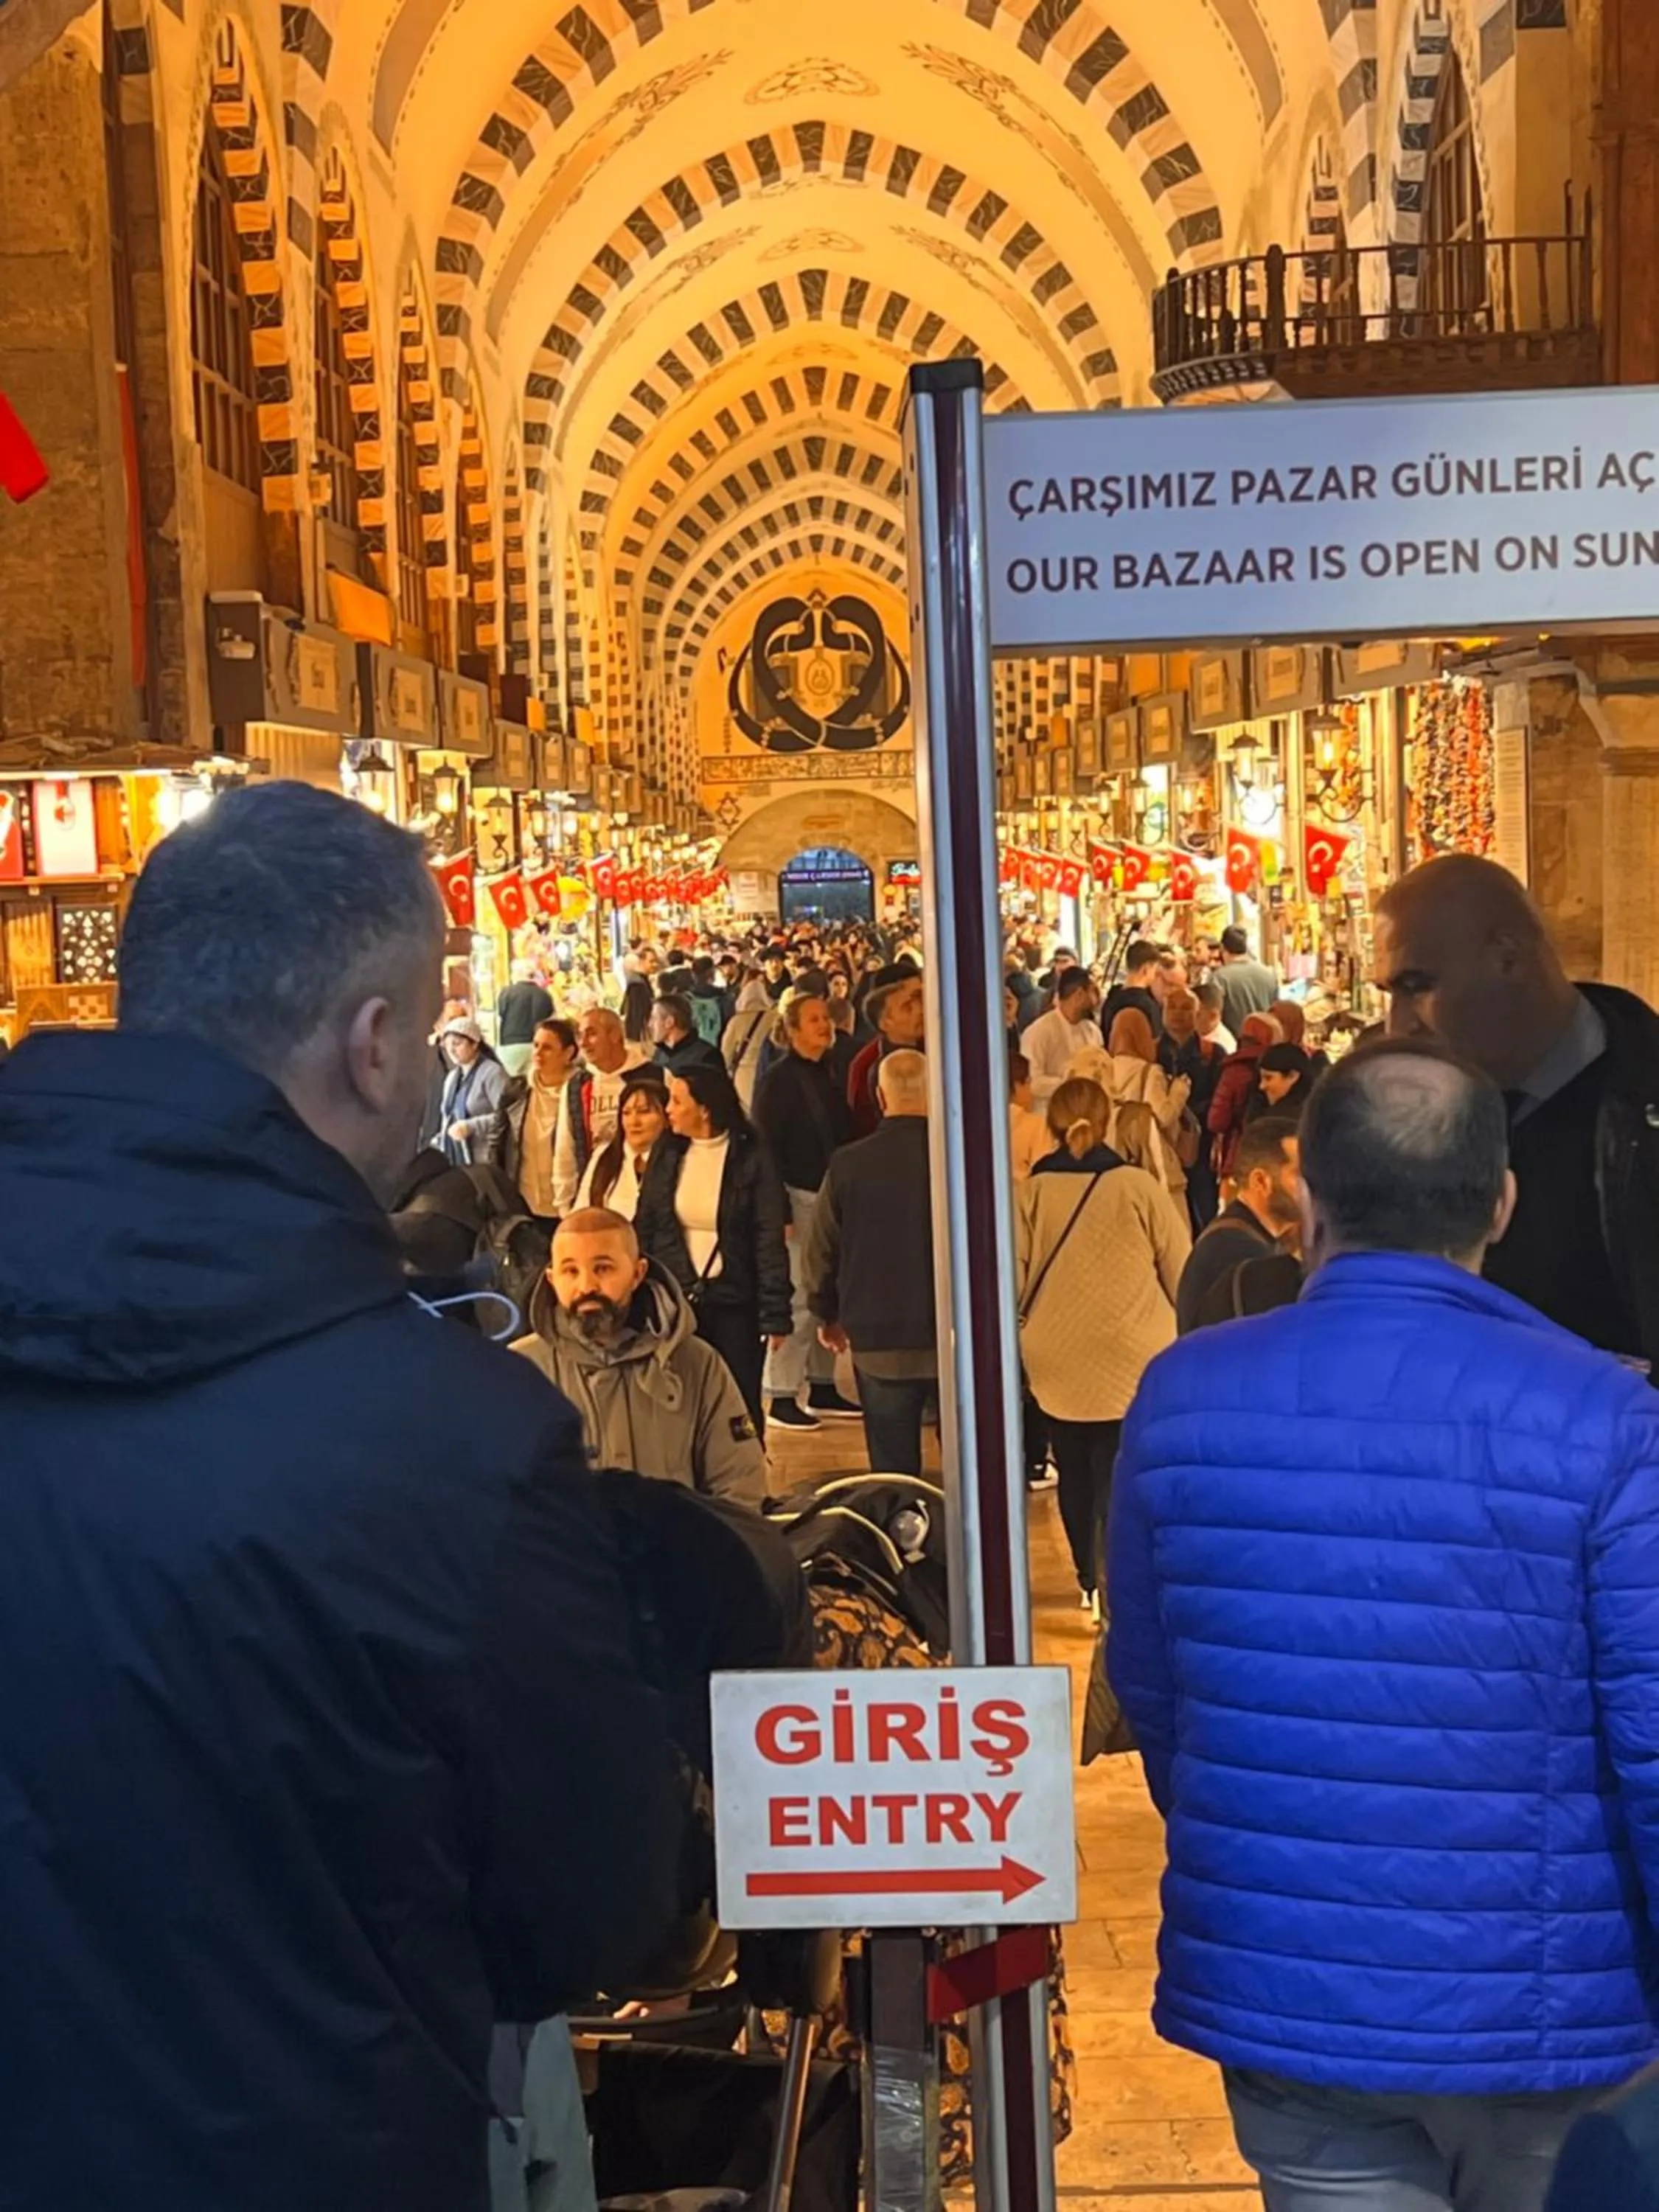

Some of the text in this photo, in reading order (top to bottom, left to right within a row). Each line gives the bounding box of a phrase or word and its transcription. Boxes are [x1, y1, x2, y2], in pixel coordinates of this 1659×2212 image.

[1008, 445, 1655, 522] ÇARŞIMIZ PAZAR GÜNLERİ AÇ
[1006, 531, 1659, 594] OUR BAZAAR IS OPEN ON SUN
[754, 1686, 1030, 1776] GİRİŞ
[768, 1792, 1023, 1847] ENTRY
